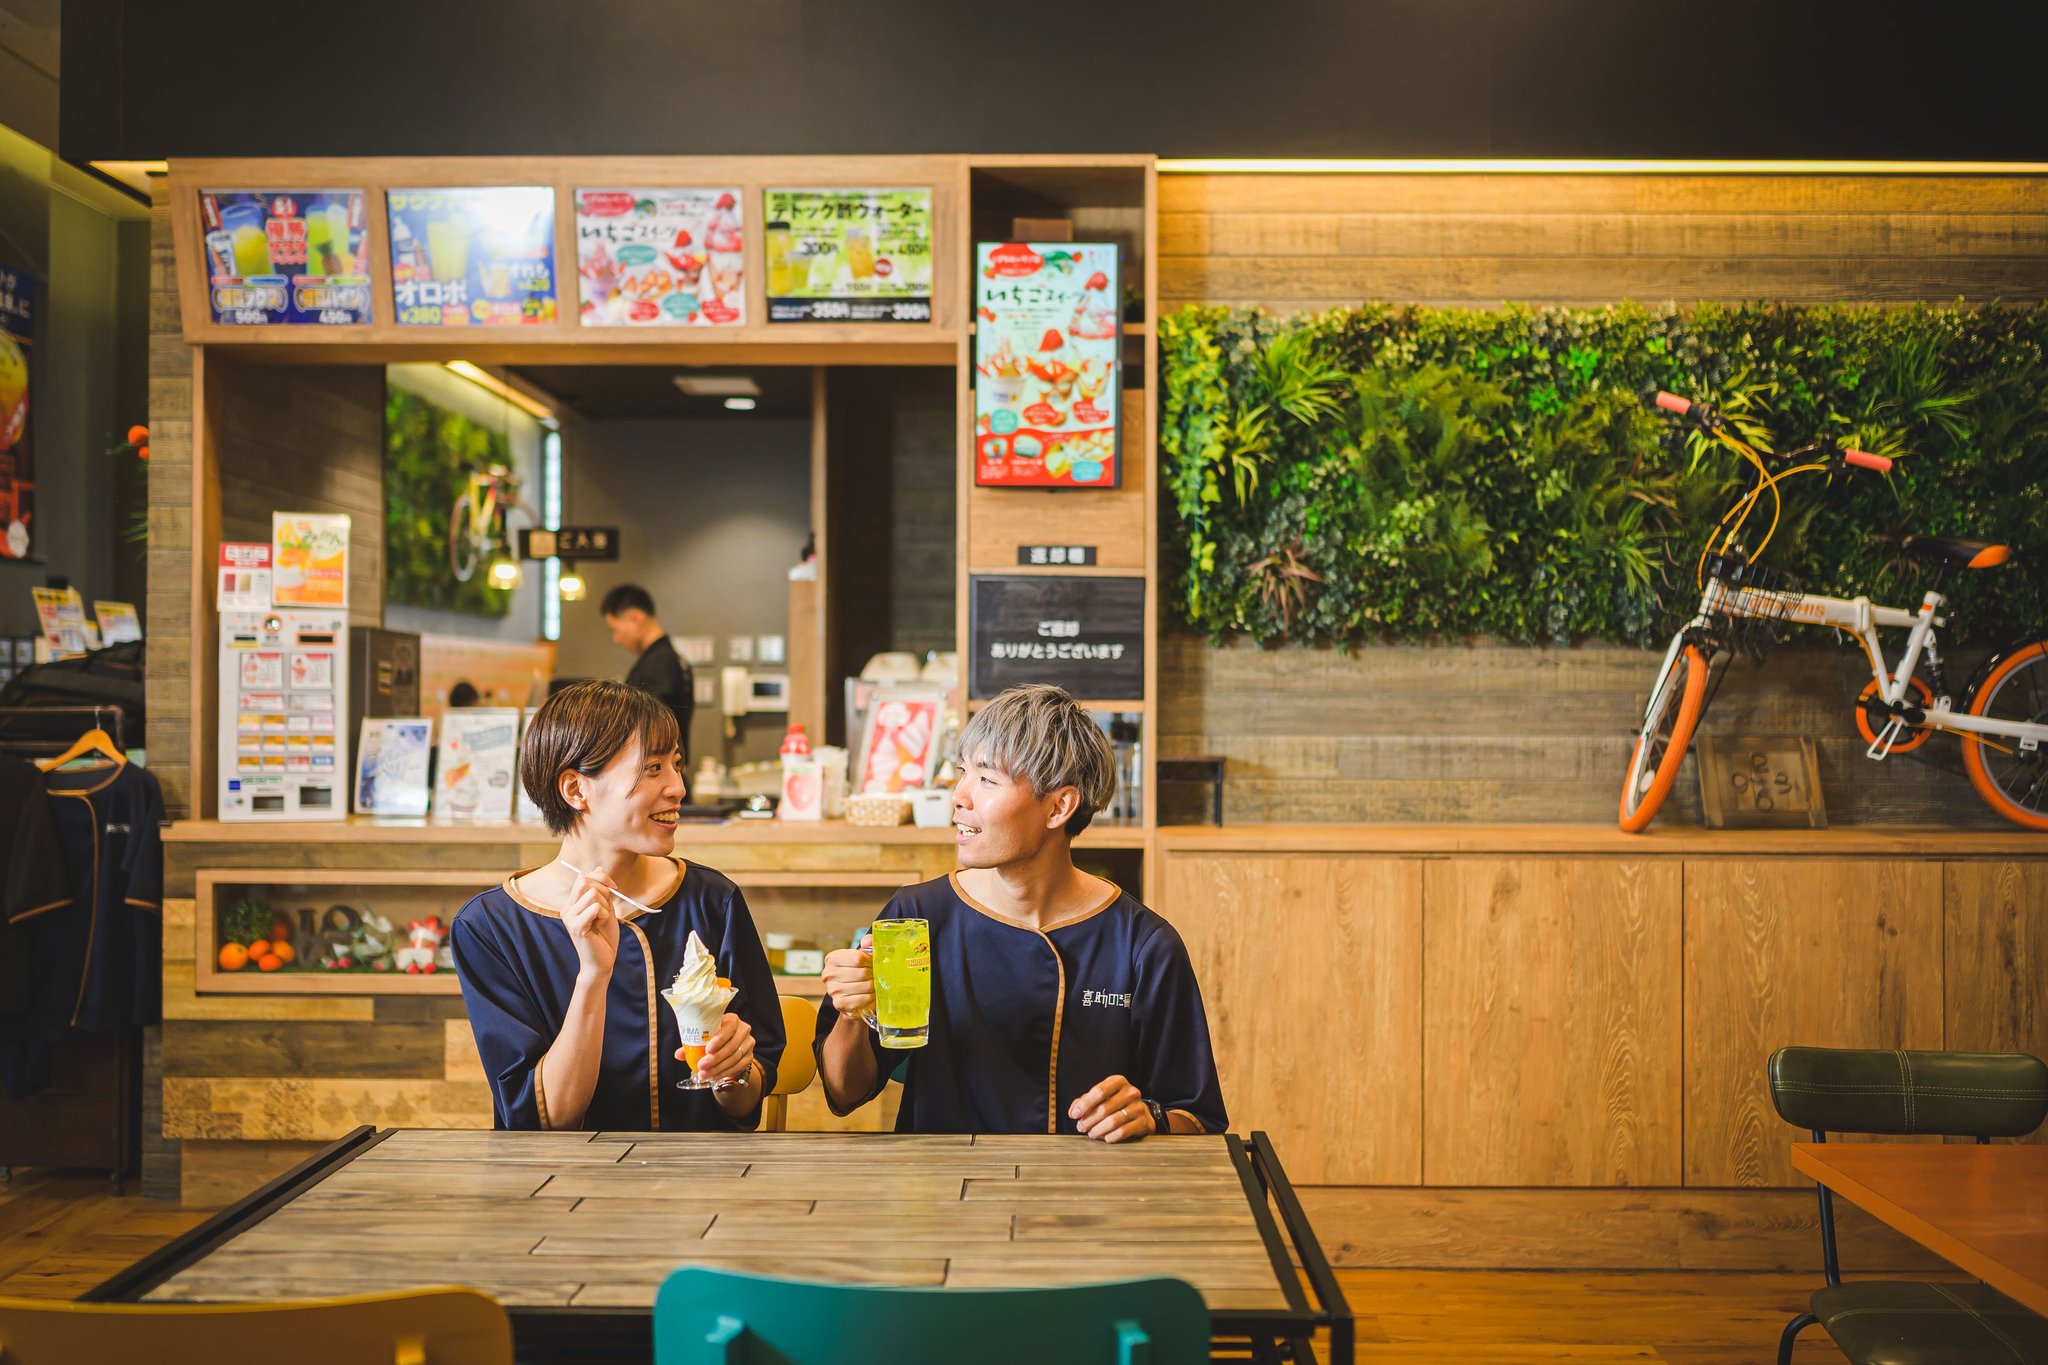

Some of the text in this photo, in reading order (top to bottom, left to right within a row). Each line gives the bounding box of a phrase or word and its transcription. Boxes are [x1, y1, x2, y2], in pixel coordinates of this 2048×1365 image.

[986, 285, 1085, 304] いちごスイーツ
[990, 643, 1125, 659] ありがとうございます
